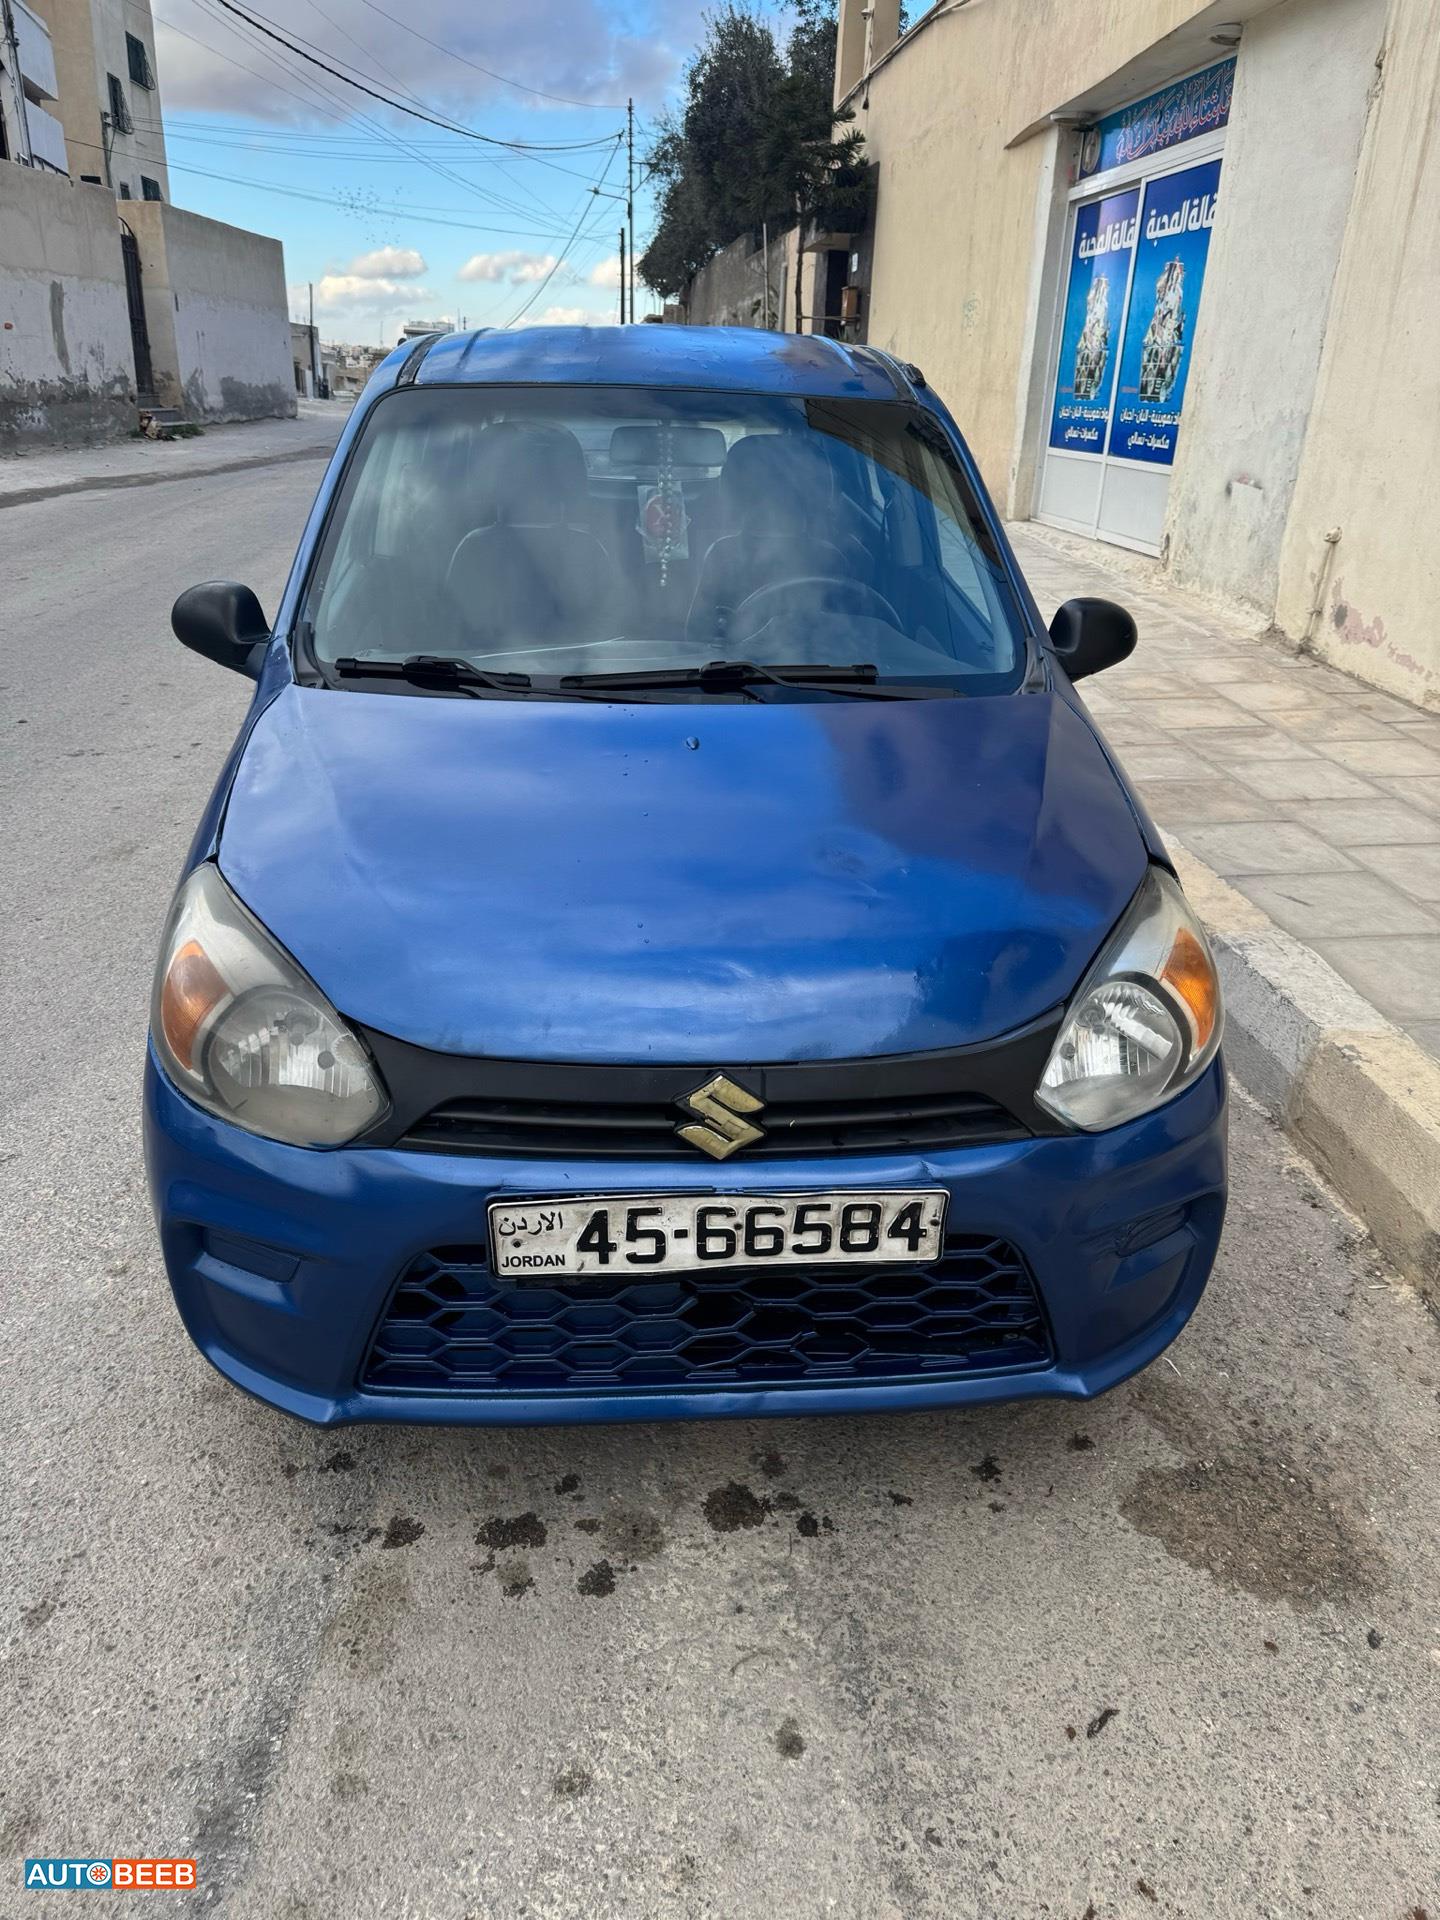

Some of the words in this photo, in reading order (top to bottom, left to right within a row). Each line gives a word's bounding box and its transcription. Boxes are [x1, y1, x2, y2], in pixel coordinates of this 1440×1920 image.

[1146, 200, 1190, 247] المحبة
[1189, 193, 1218, 231] قالة
[1079, 224, 1112, 264] المحبة
[1112, 217, 1137, 251] قالة
[498, 1210, 563, 1237] الاردن
[576, 1202, 927, 1264] 45-66584
[501, 1254, 566, 1268] JORDAN
